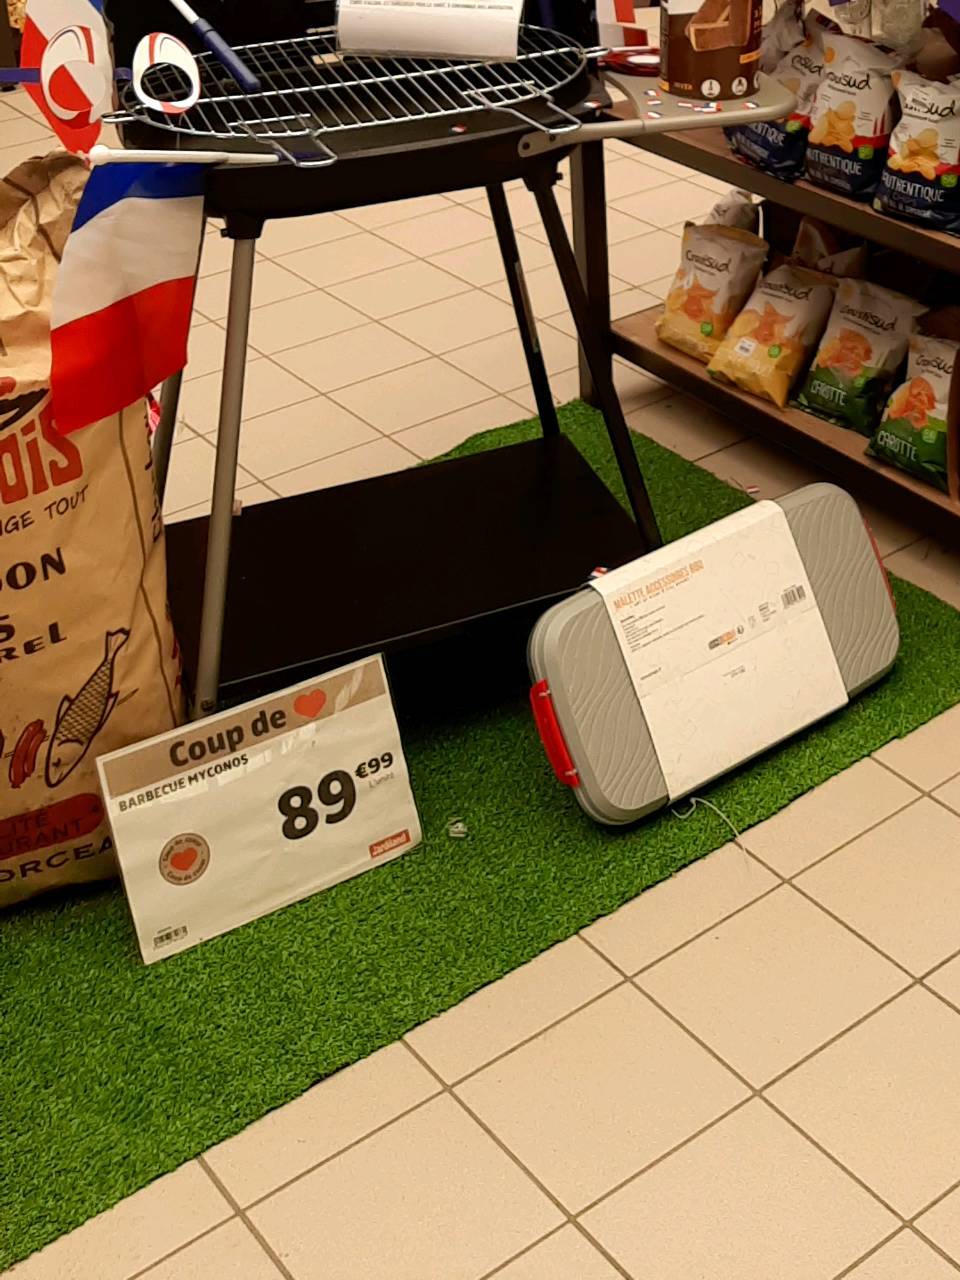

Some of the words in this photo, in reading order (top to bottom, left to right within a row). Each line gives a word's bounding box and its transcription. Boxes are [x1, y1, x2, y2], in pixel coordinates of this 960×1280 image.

[44, 484, 89, 520] TOUT
[0, 546, 66, 592] ON
[169, 724, 245, 768] Coup
[251, 709, 287, 738] de
[119, 776, 186, 813] BARBECUE
[188, 753, 249, 786] MYCONOS
[277, 769, 358, 841] 89
[355, 751, 394, 780] €99
